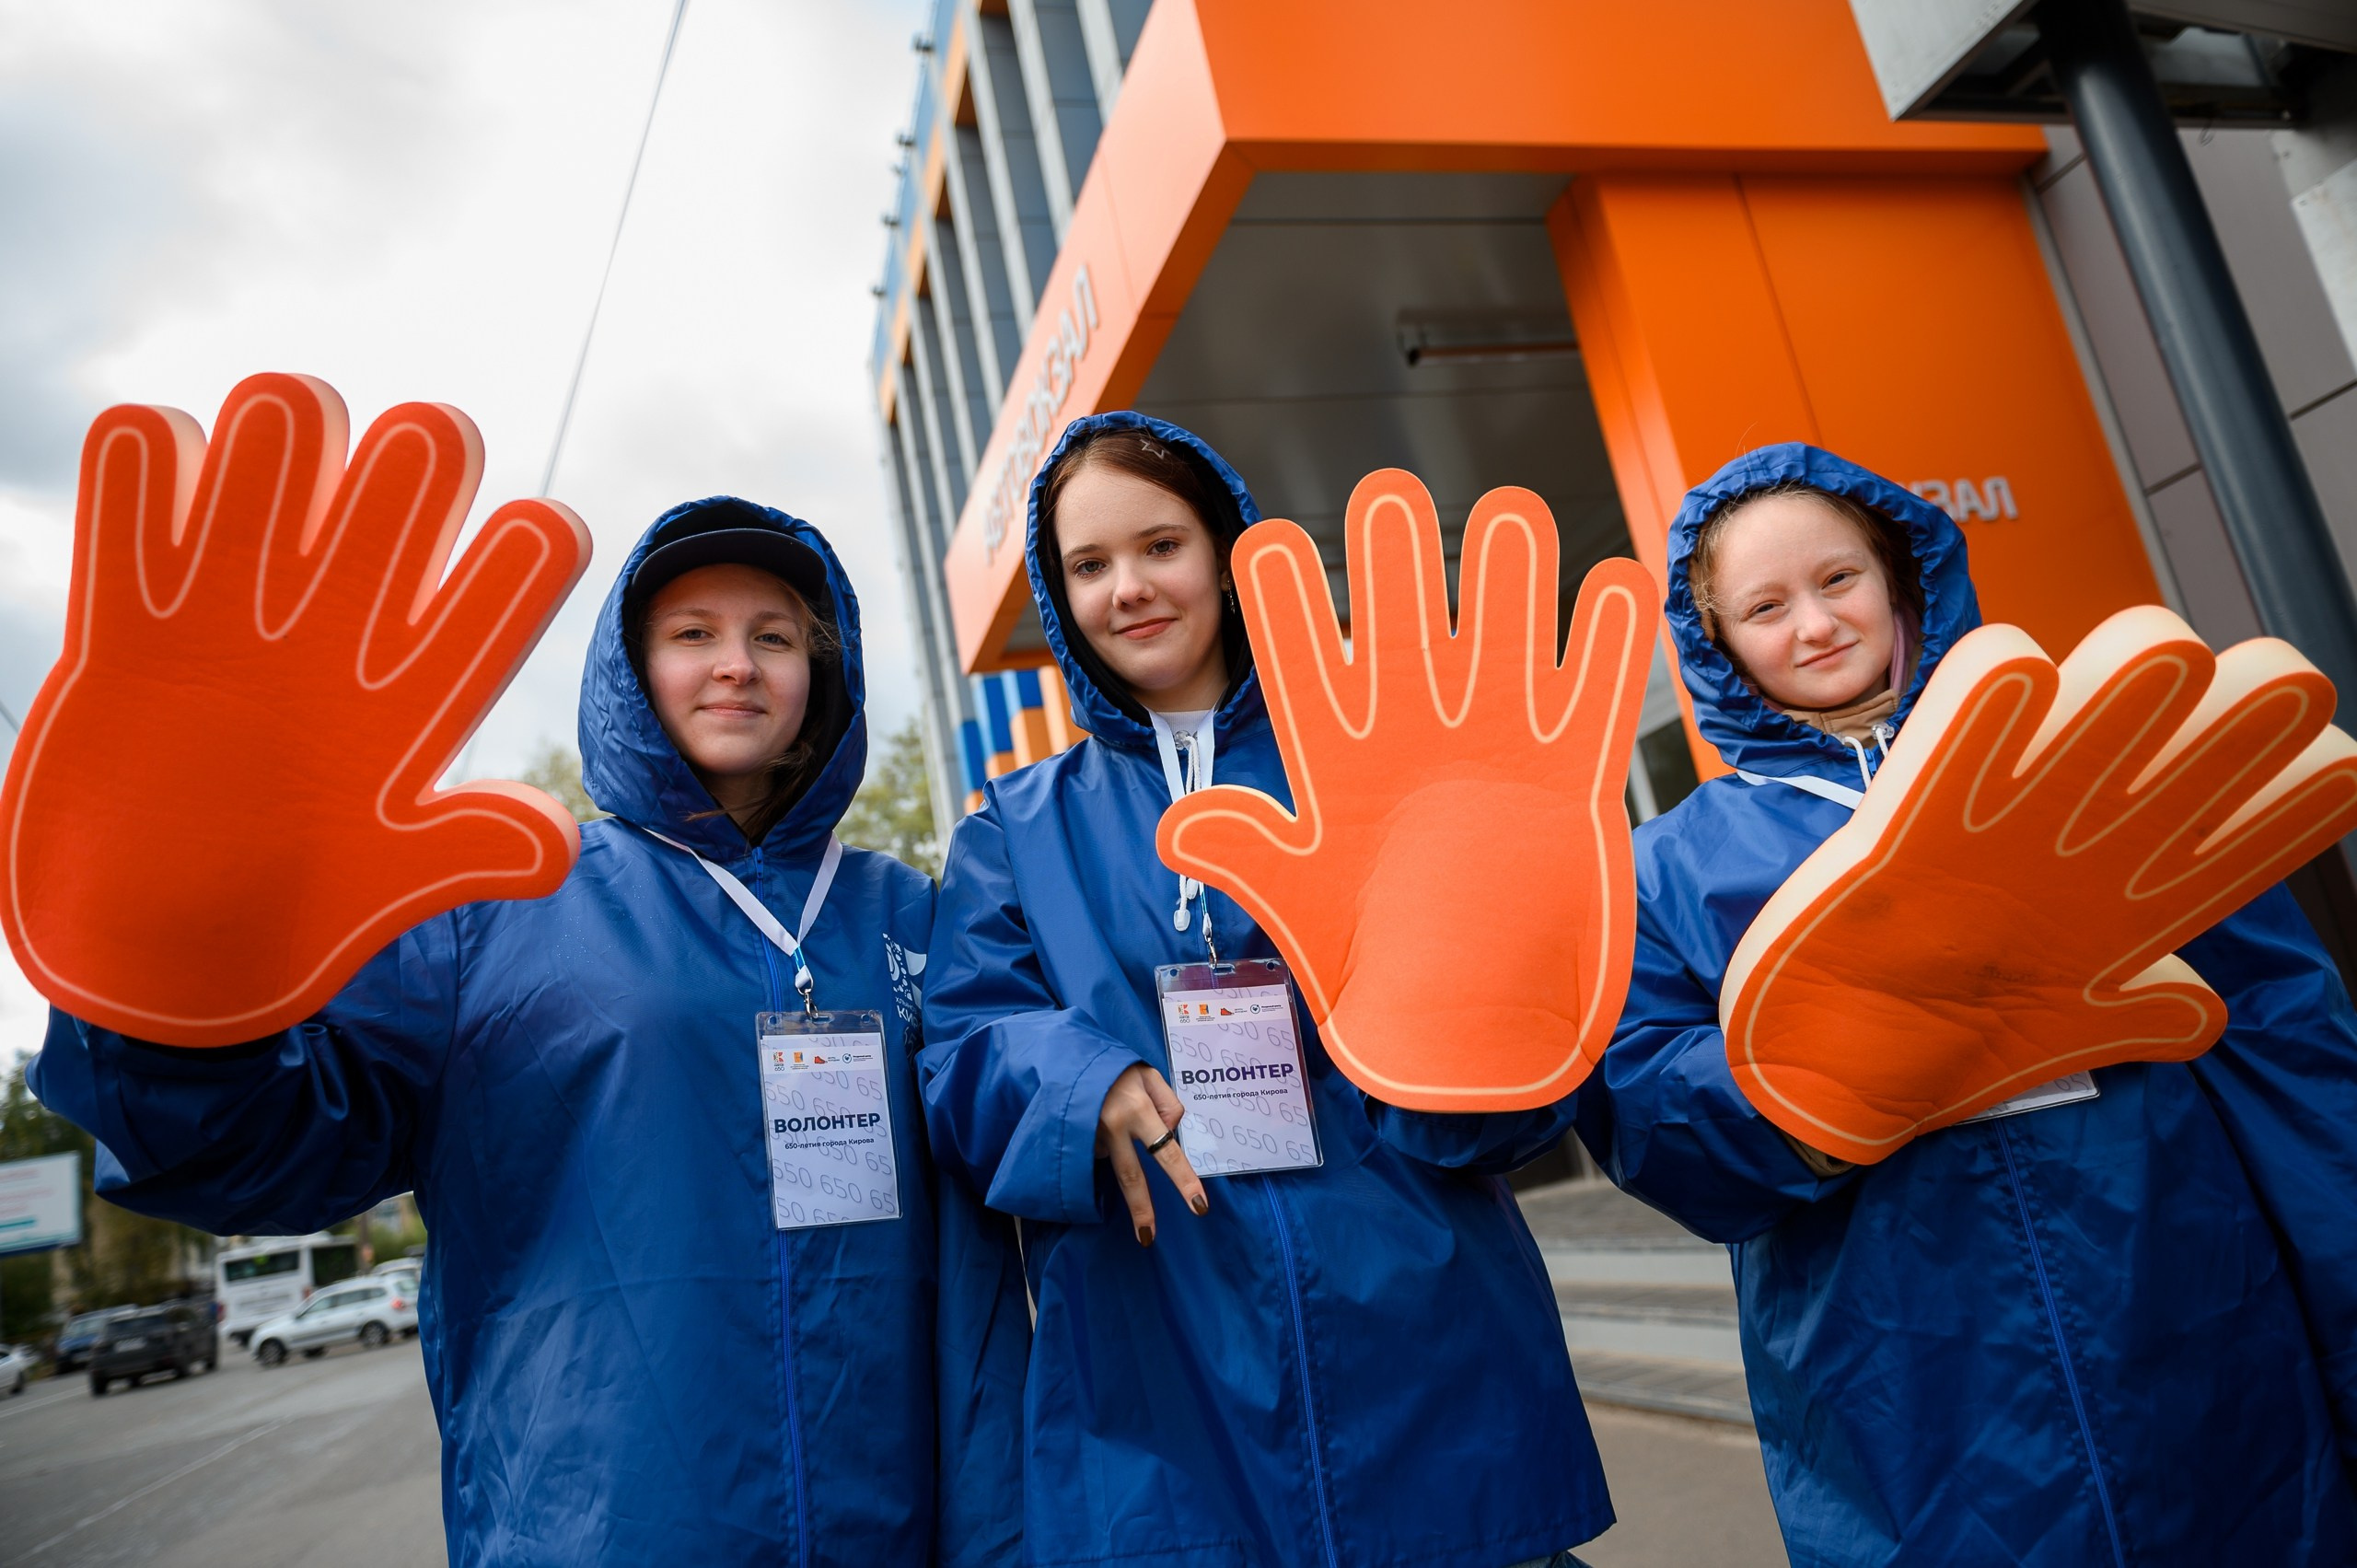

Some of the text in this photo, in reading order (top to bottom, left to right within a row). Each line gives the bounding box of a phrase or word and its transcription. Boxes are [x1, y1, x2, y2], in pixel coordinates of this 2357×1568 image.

[983, 264, 1098, 564] АВТОВОКЗАЛ
[897, 1005, 922, 1028] КИР
[1181, 1063, 1294, 1085] ВОЛОНТЕР
[1193, 1088, 1288, 1101] 650-летия города Кирова
[774, 1112, 880, 1133] ВОЛОНТЕР
[822, 1139, 848, 1148] города
[849, 1137, 875, 1145] Кирова
